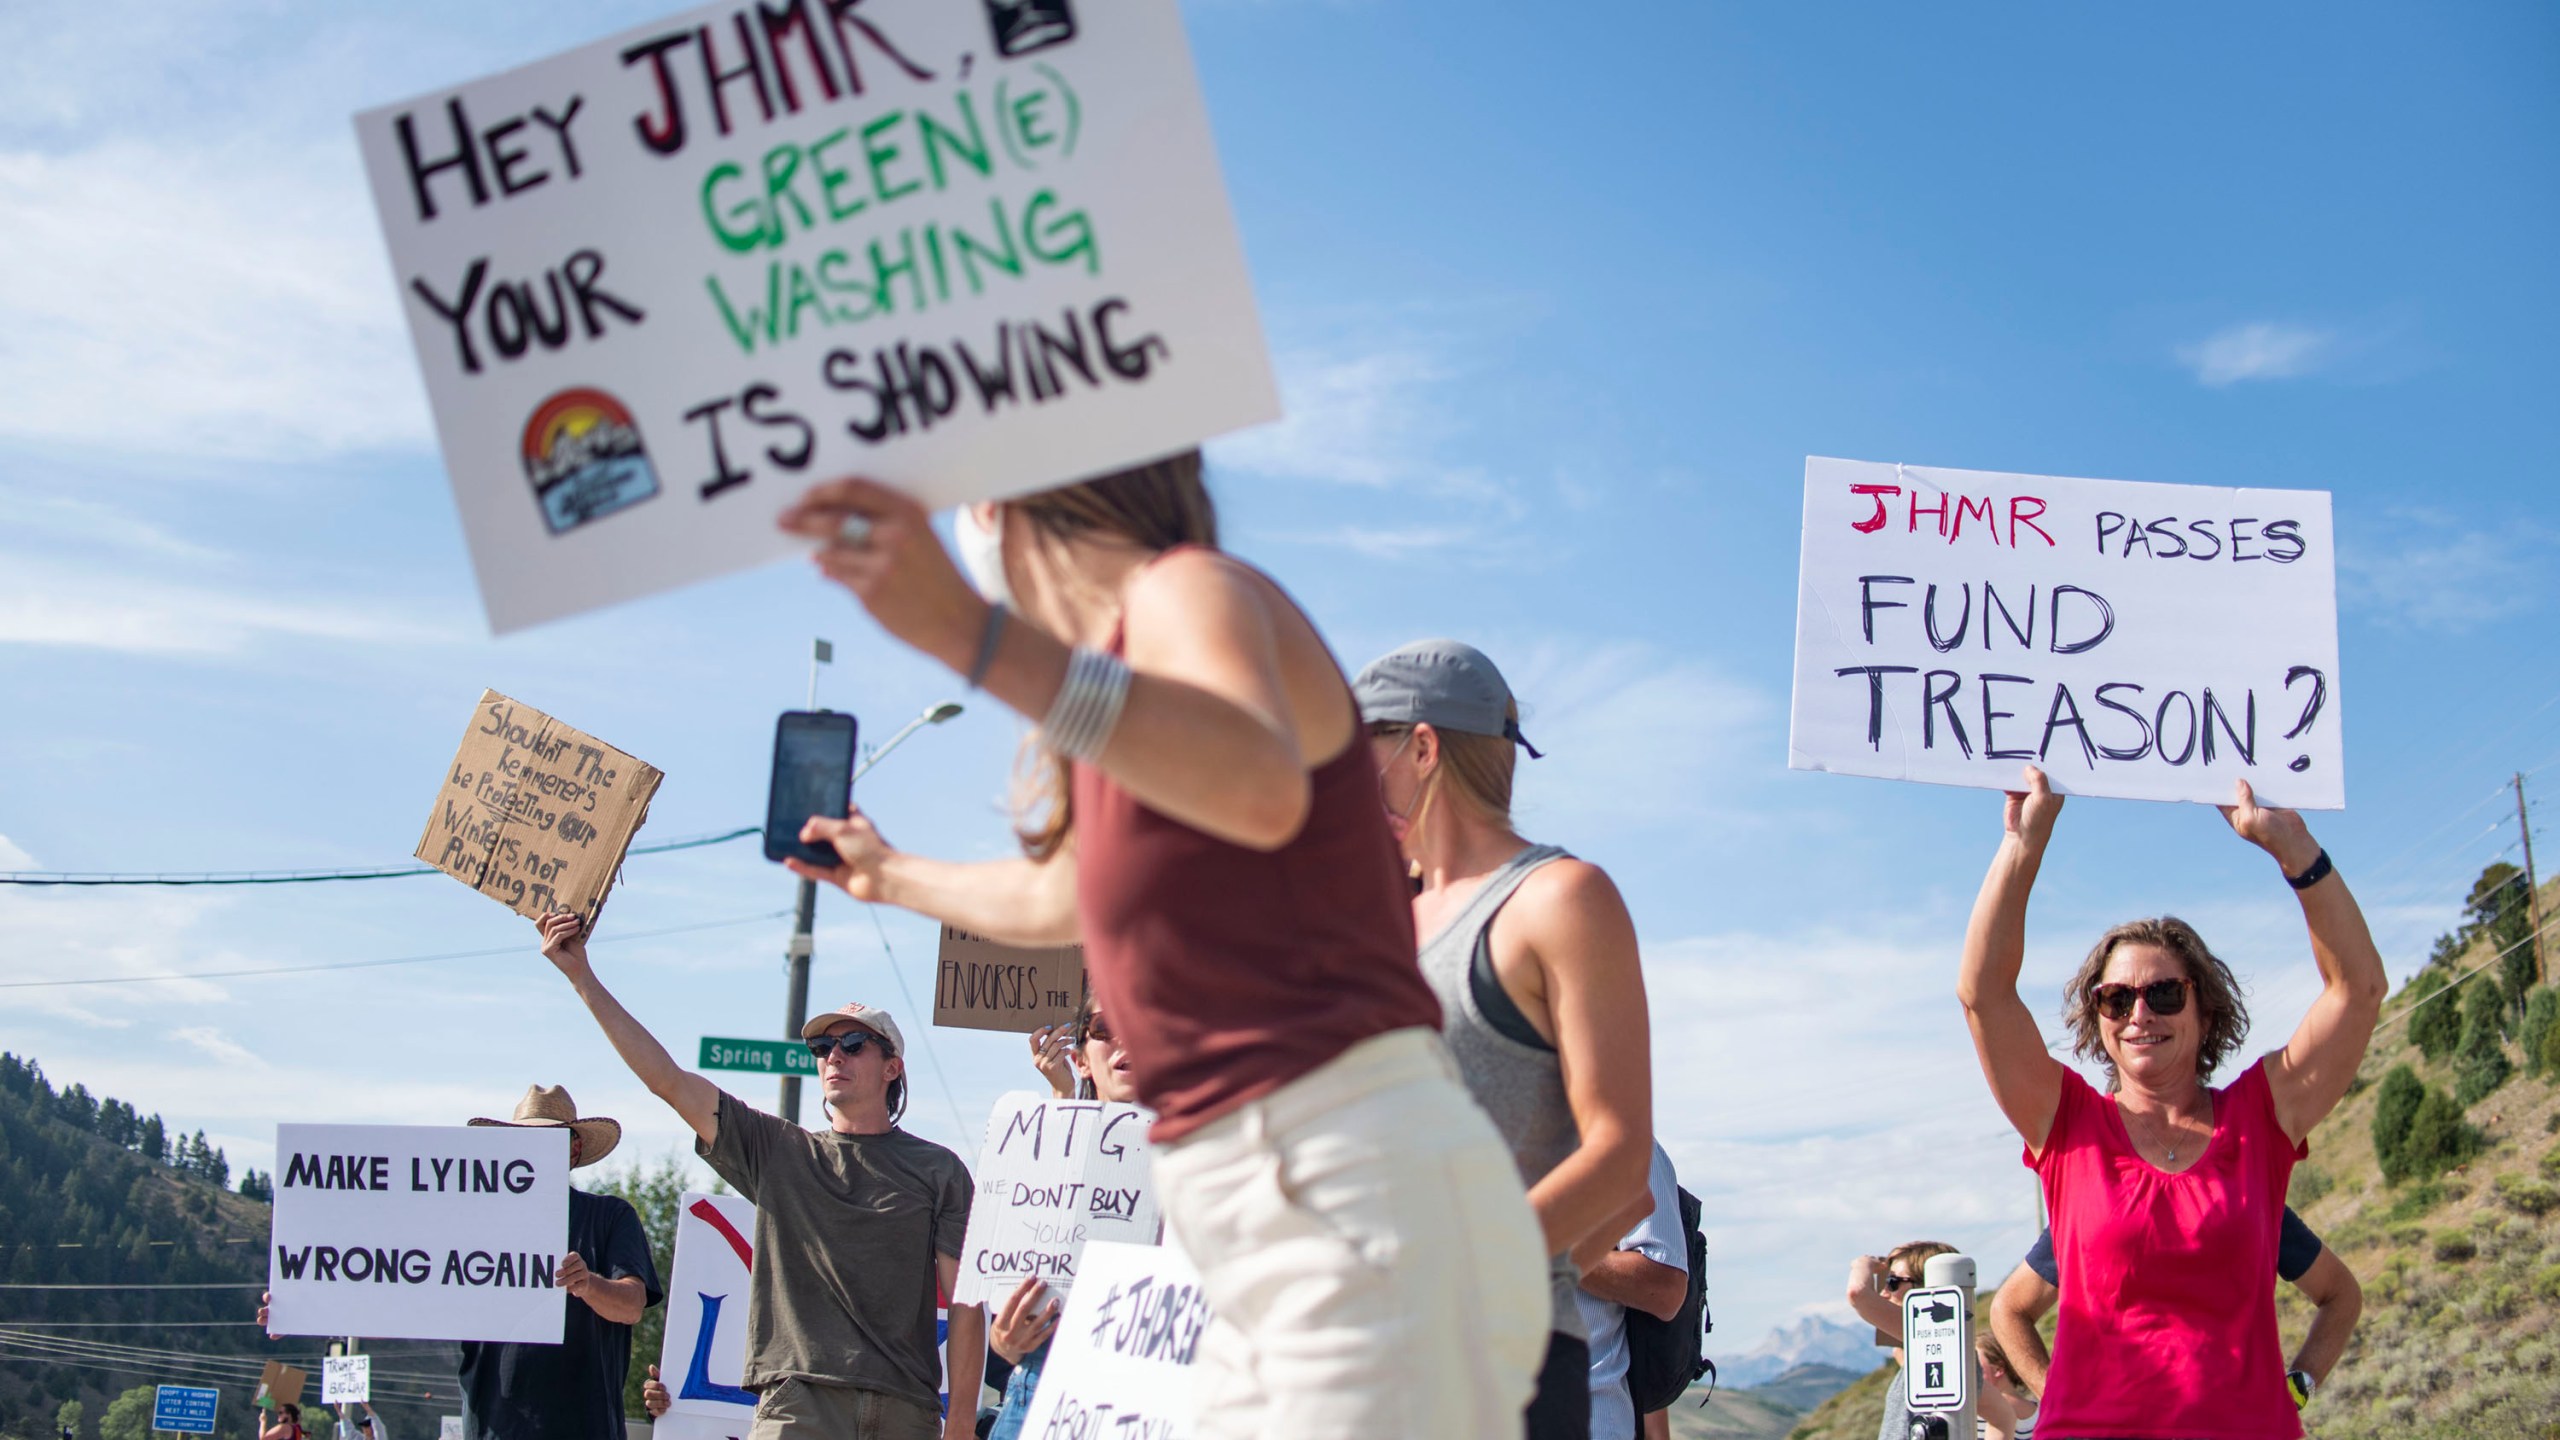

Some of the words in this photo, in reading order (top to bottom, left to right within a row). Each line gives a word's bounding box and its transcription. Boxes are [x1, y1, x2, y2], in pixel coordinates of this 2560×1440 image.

[394, 95, 585, 221] HEY
[700, 61, 1081, 252] GREEN(E)
[705, 189, 1101, 354] WASHING
[411, 250, 646, 374] YOUR
[683, 385, 815, 501] IS
[822, 298, 1171, 443] SHOWING
[1849, 483, 2055, 549] JHMR
[2096, 511, 2306, 563] PASSES
[1859, 575, 2115, 654] FUND
[1834, 665, 2326, 773] TREASON?
[452, 763, 473, 788] be
[574, 743, 617, 788] The
[939, 960, 1038, 1010] ENDORSES
[1046, 990, 1070, 1008] THE
[710, 1044, 773, 1070] Spring
[284, 1153, 389, 1190] MAKE
[412, 1157, 535, 1194] LYING
[982, 1179, 1008, 1195] WE
[1011, 1182, 1085, 1209] DON'T
[1089, 1187, 1141, 1217] BUY
[1022, 1220, 1088, 1245] YOUR
[278, 1245, 431, 1284] WRONG
[441, 1250, 554, 1289] AGAIN
[1917, 1329, 1931, 1338] PUSH
[1934, 1328, 1955, 1337] BUTTON
[1926, 1344, 1942, 1355] FOR
[356, 1358, 368, 1371] IS
